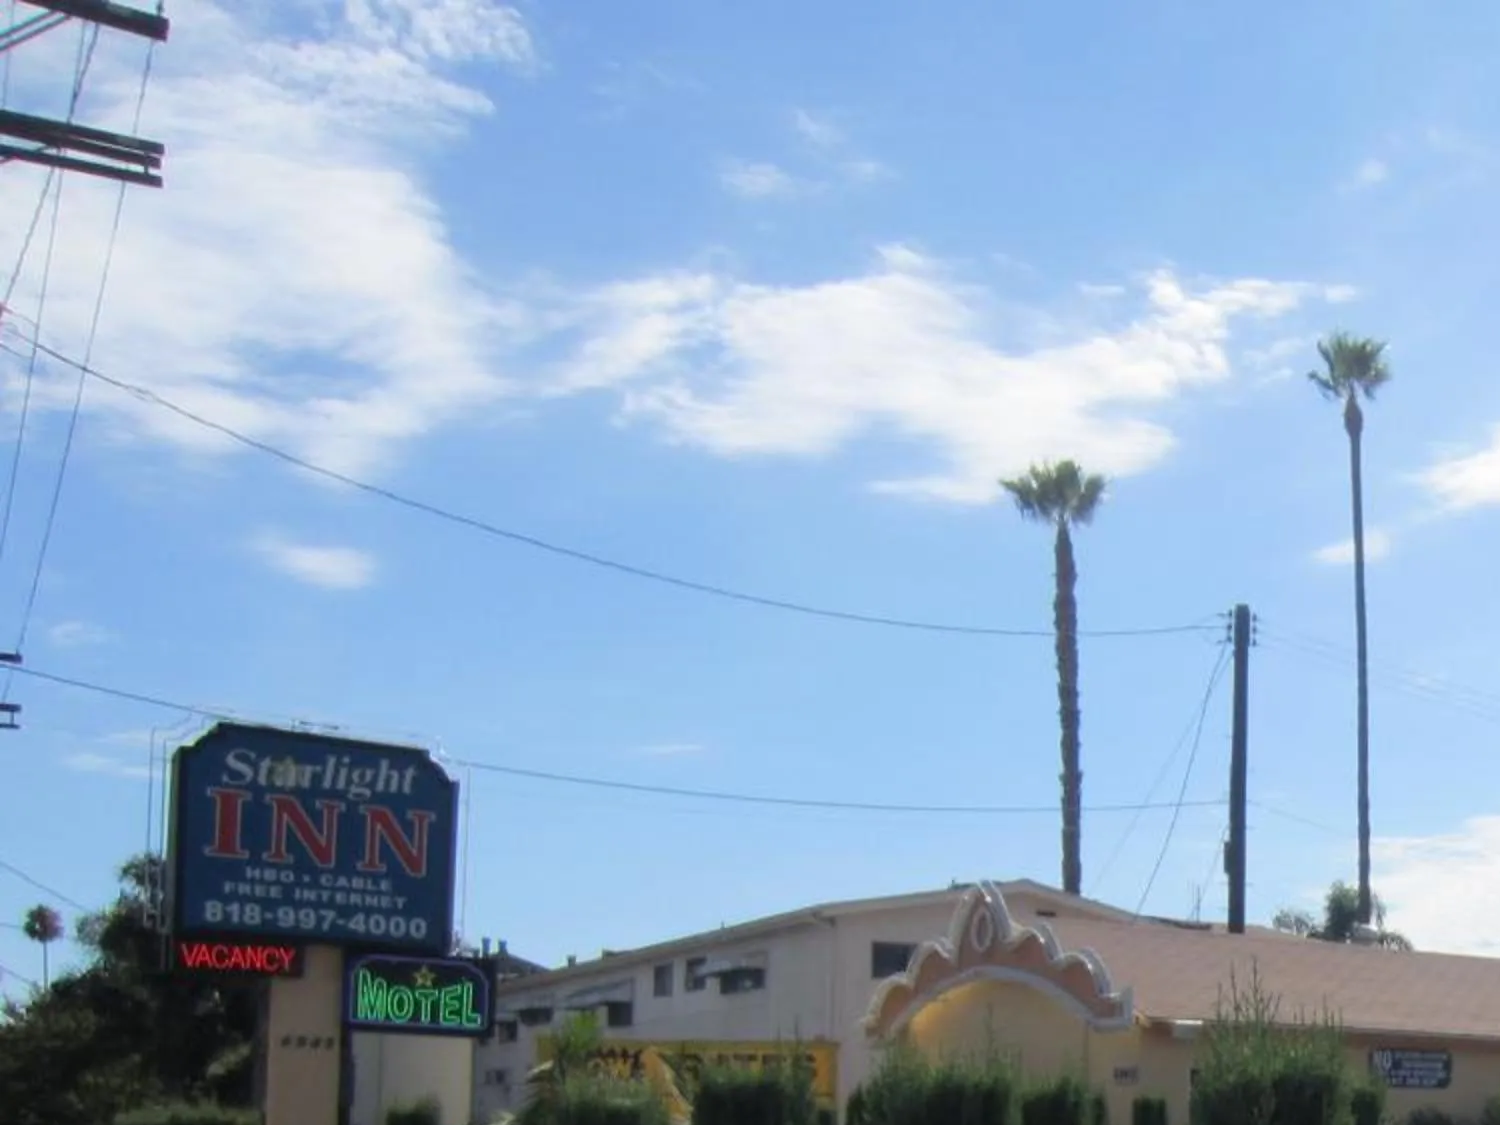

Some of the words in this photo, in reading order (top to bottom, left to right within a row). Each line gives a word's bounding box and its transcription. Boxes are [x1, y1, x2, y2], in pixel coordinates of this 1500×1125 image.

[222, 748, 417, 798] Starlight
[203, 787, 436, 878] INN
[224, 881, 283, 898] FREE
[294, 887, 408, 910] INTERNET
[245, 866, 295, 883] HBO
[319, 873, 392, 892] CABLE
[203, 899, 428, 939] 818-997-4000
[181, 943, 295, 972] VACANCY
[356, 968, 482, 1027] MOTEL
